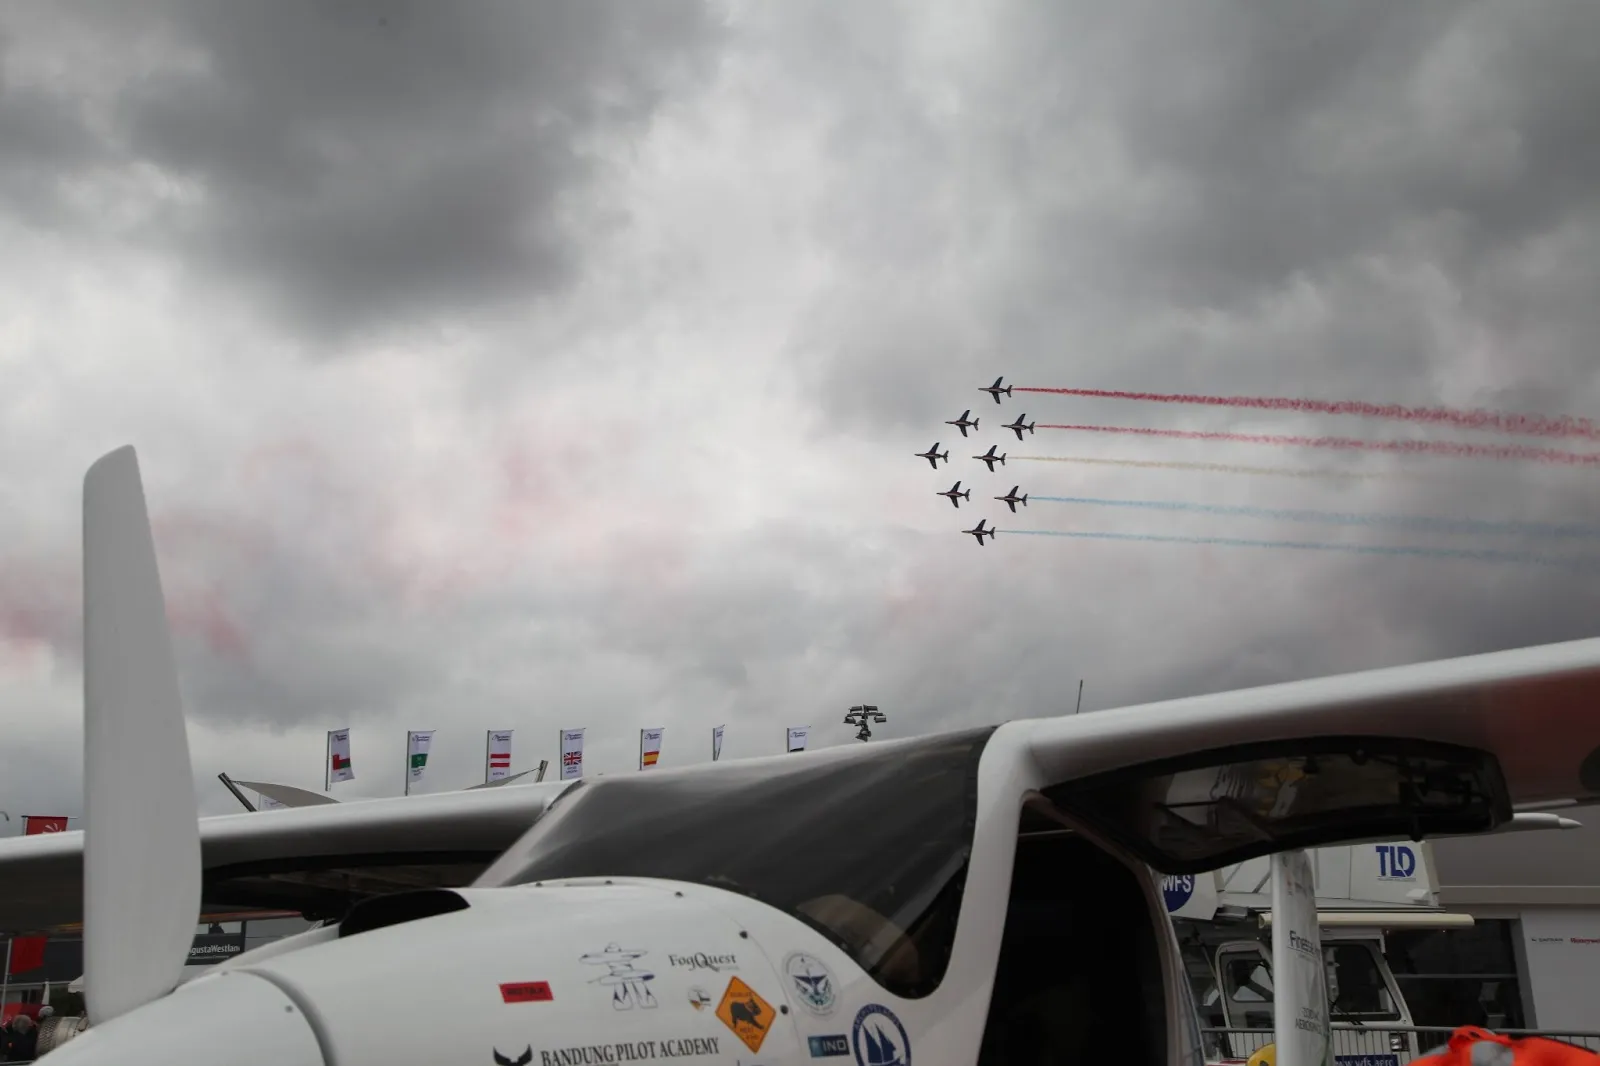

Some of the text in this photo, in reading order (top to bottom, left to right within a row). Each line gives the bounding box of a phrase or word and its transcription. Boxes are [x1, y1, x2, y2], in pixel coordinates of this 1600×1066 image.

[1375, 846, 1416, 878] TLD
[1163, 874, 1192, 894] WFS
[668, 952, 737, 972] FogQuest
[540, 1036, 720, 1066] BANDUNG PILOT ACADEMY
